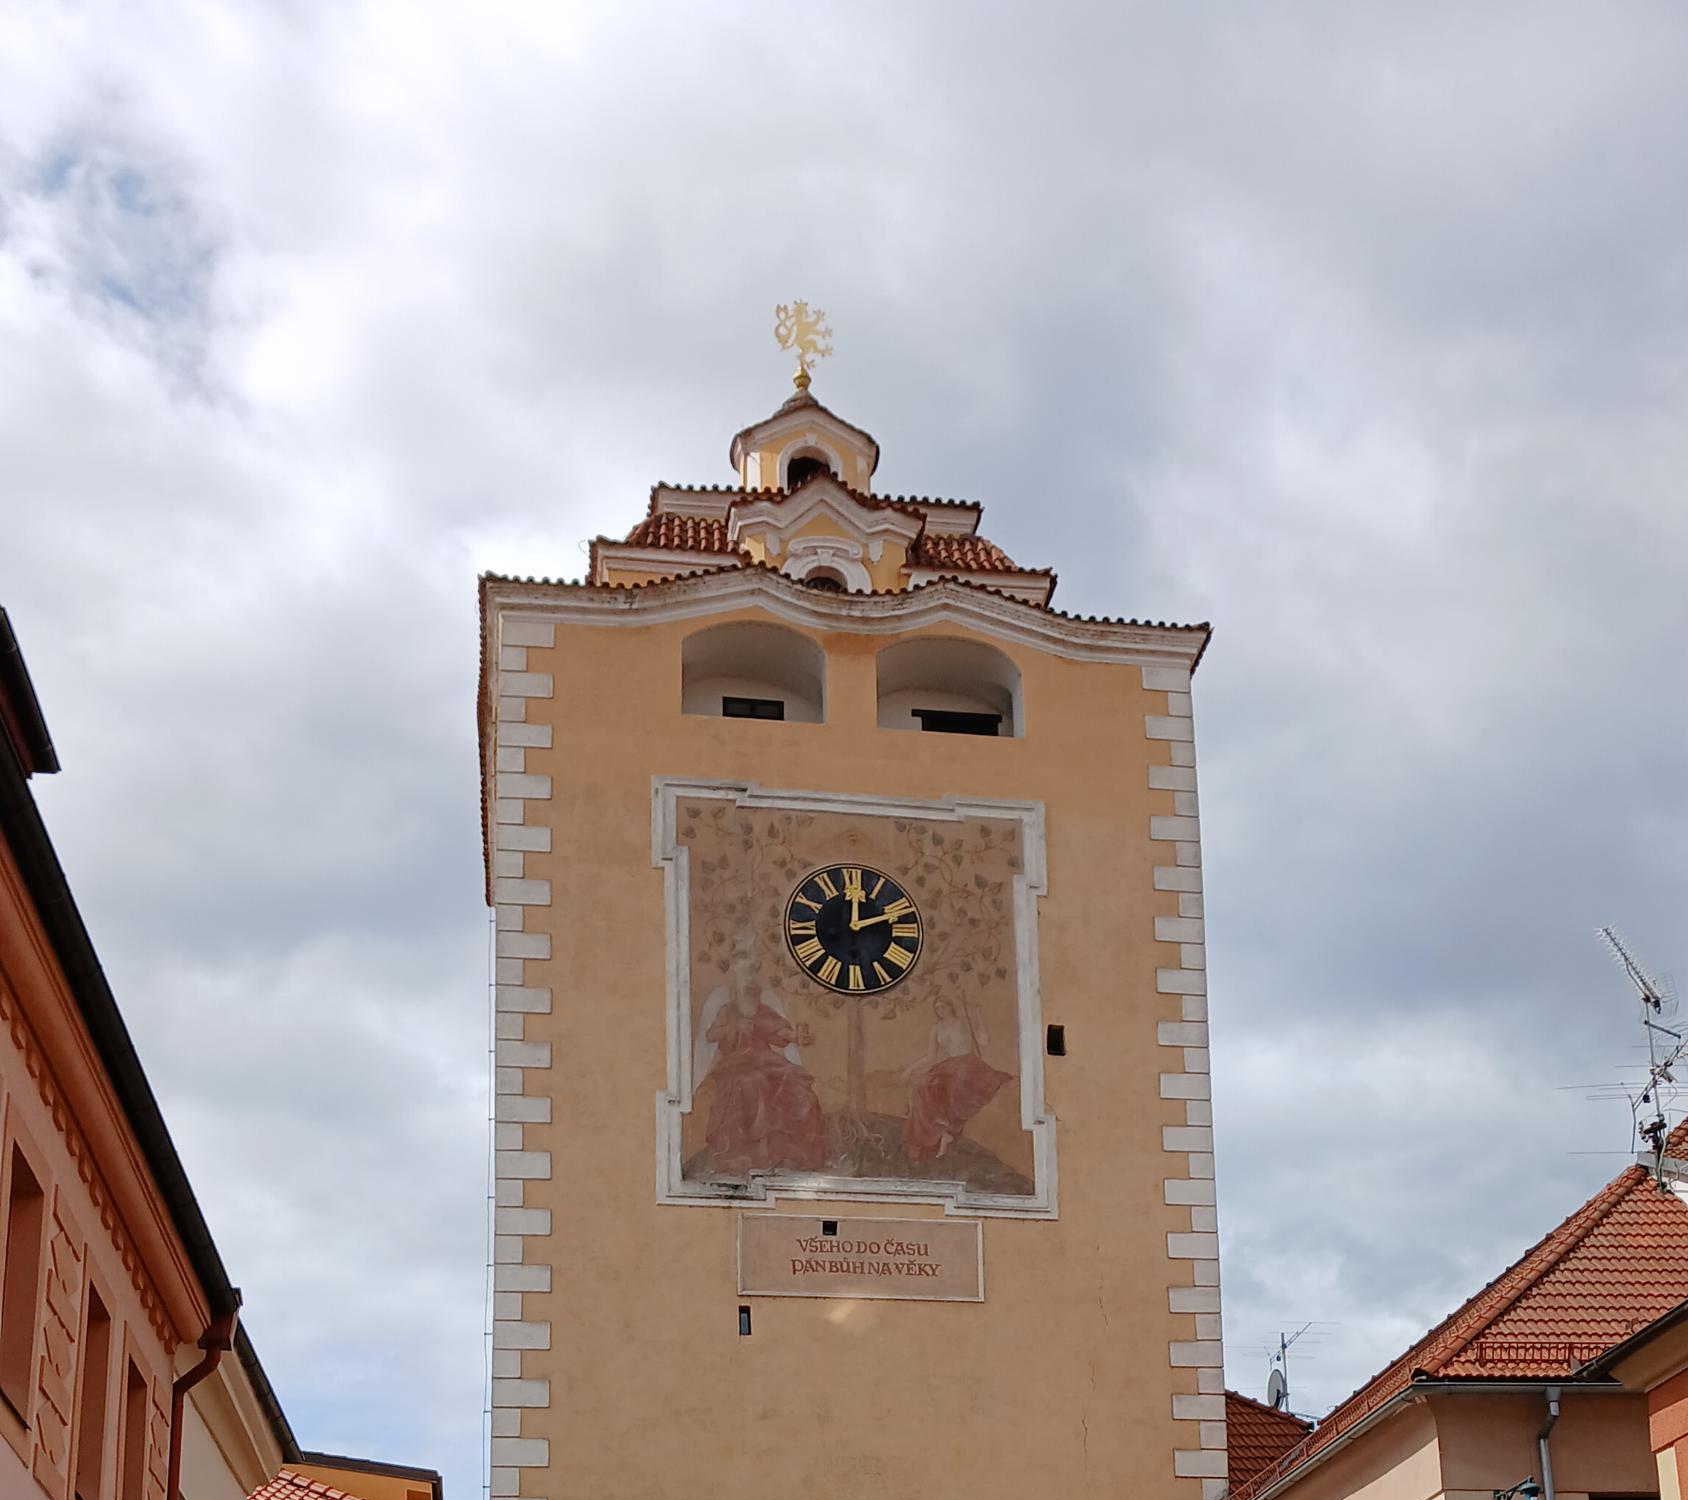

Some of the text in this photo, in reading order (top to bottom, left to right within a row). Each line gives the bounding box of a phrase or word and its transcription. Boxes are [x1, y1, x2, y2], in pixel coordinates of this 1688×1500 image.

[796, 1236, 929, 1256] VŠEHO DO ČASU
[791, 1256, 942, 1277] PÁN BŮH NA VĚKY
